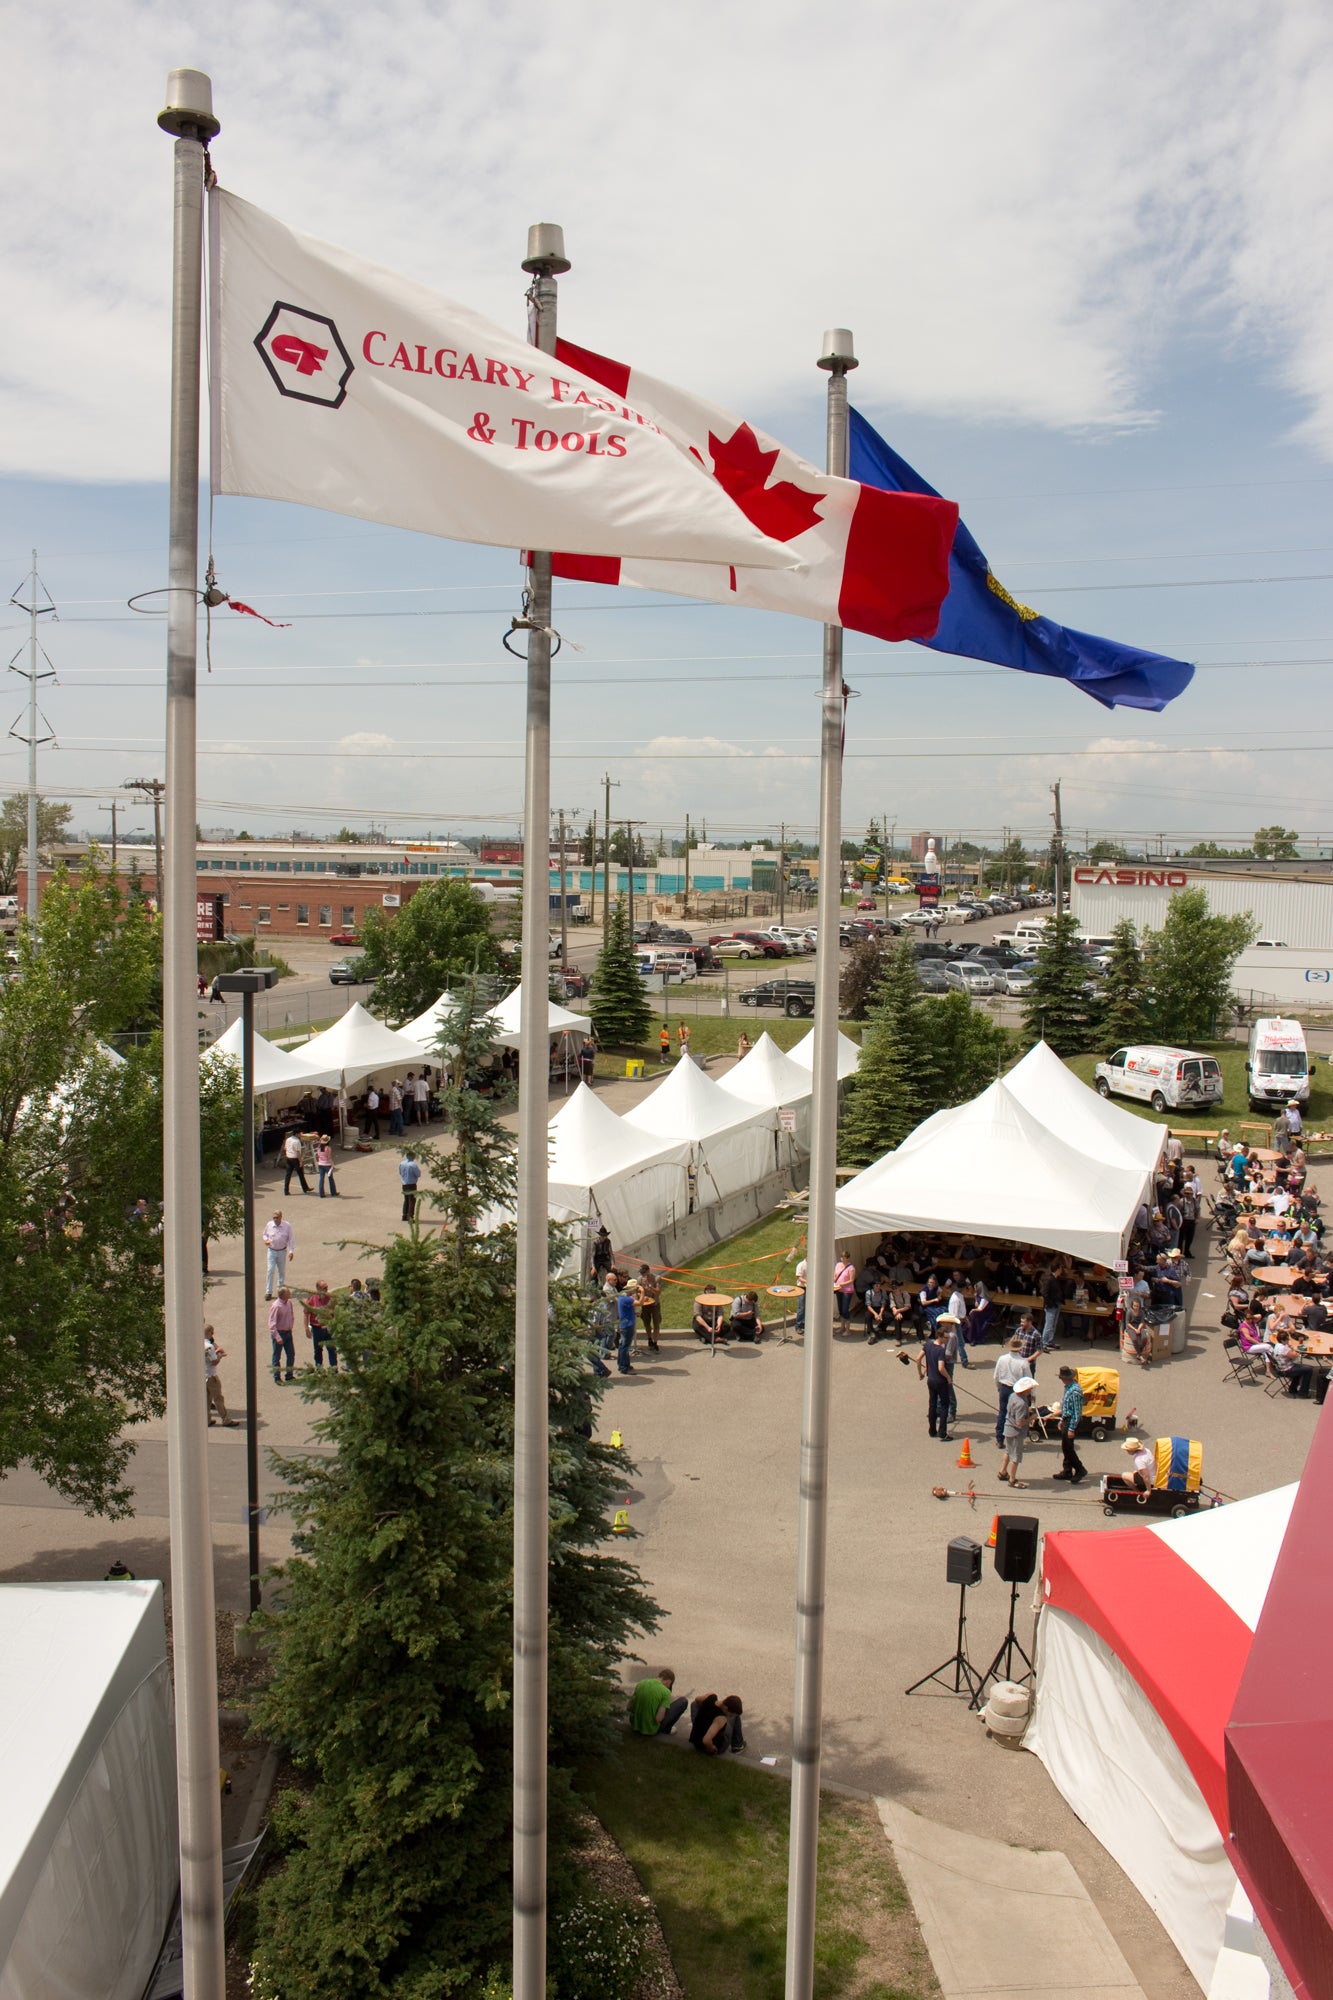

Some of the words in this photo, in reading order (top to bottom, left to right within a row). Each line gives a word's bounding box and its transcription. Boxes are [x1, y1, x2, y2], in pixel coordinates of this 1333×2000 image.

[362, 331, 535, 392] CALGARY
[467, 412, 496, 445] &
[512, 418, 627, 457] TOOLS
[1074, 869, 1187, 887] CASINO
